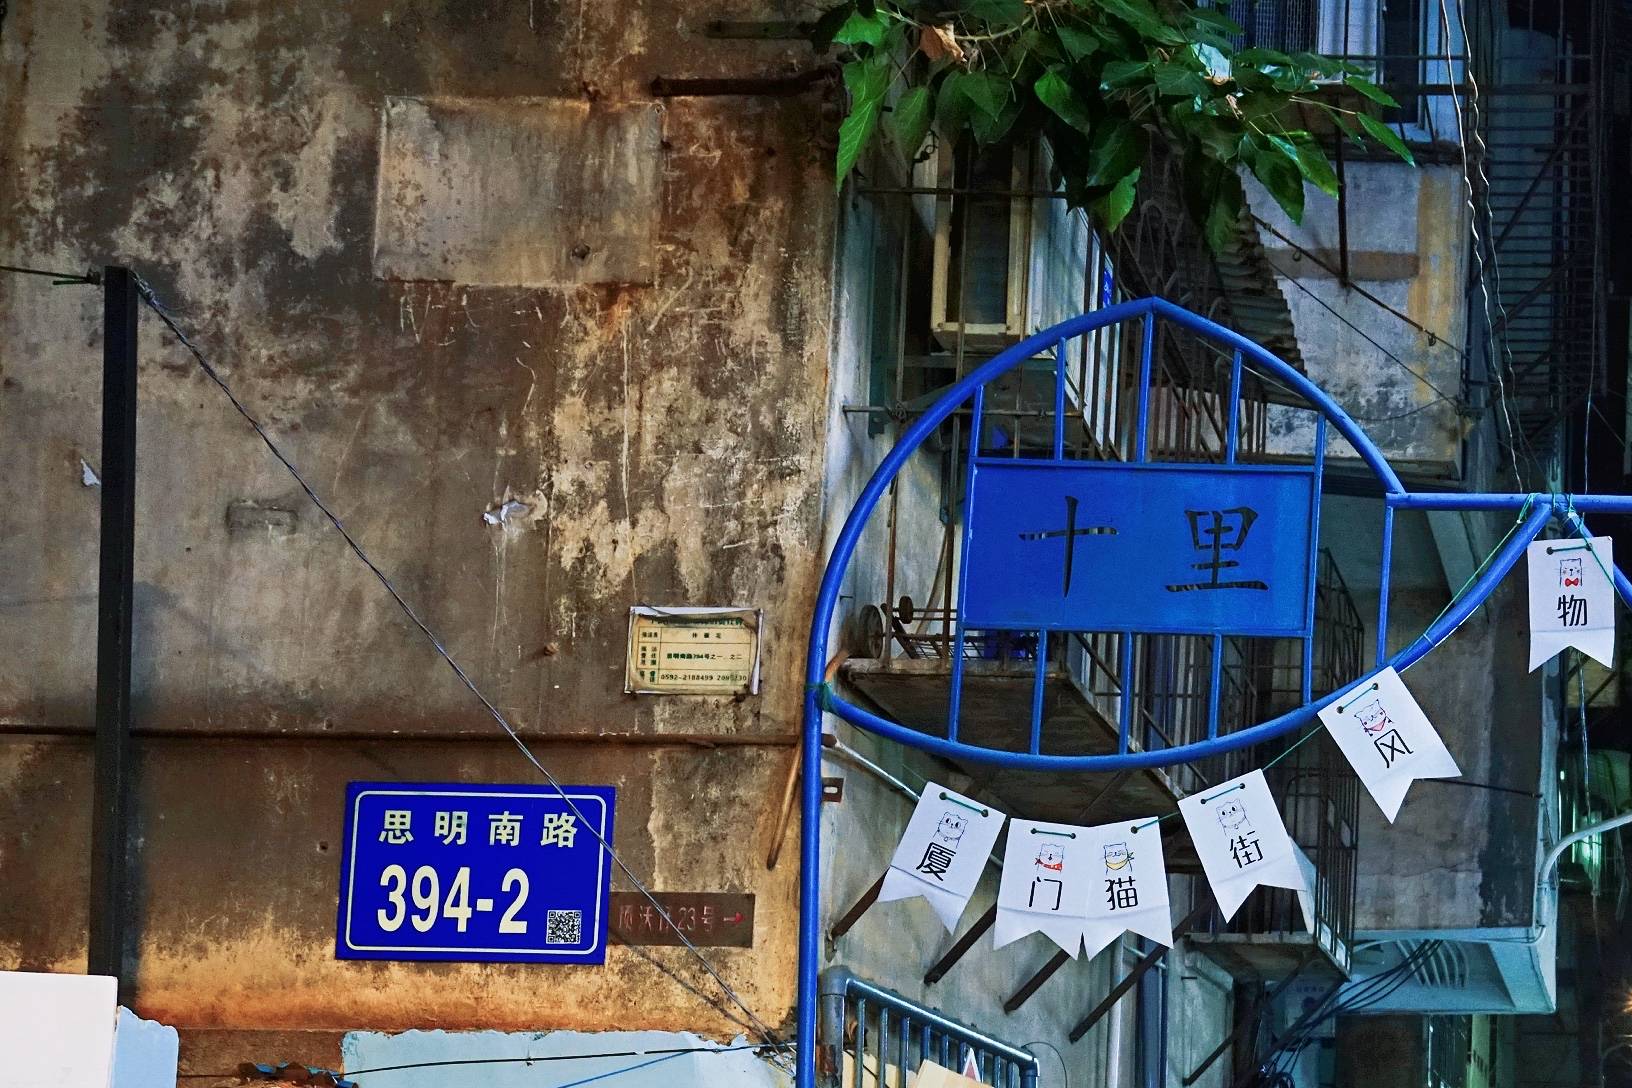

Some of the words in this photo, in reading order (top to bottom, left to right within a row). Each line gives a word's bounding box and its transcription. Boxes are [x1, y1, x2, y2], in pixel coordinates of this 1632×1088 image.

[1018, 495, 1269, 598] 十里
[916, 841, 956, 882] 厦
[1028, 876, 1062, 911] 门
[1105, 876, 1139, 911] 猫
[1229, 831, 1263, 869] 街
[1374, 728, 1415, 769] 风
[1557, 594, 1588, 628] 物
[378, 809, 579, 849] 思明南路
[376, 863, 530, 935] 394-2
